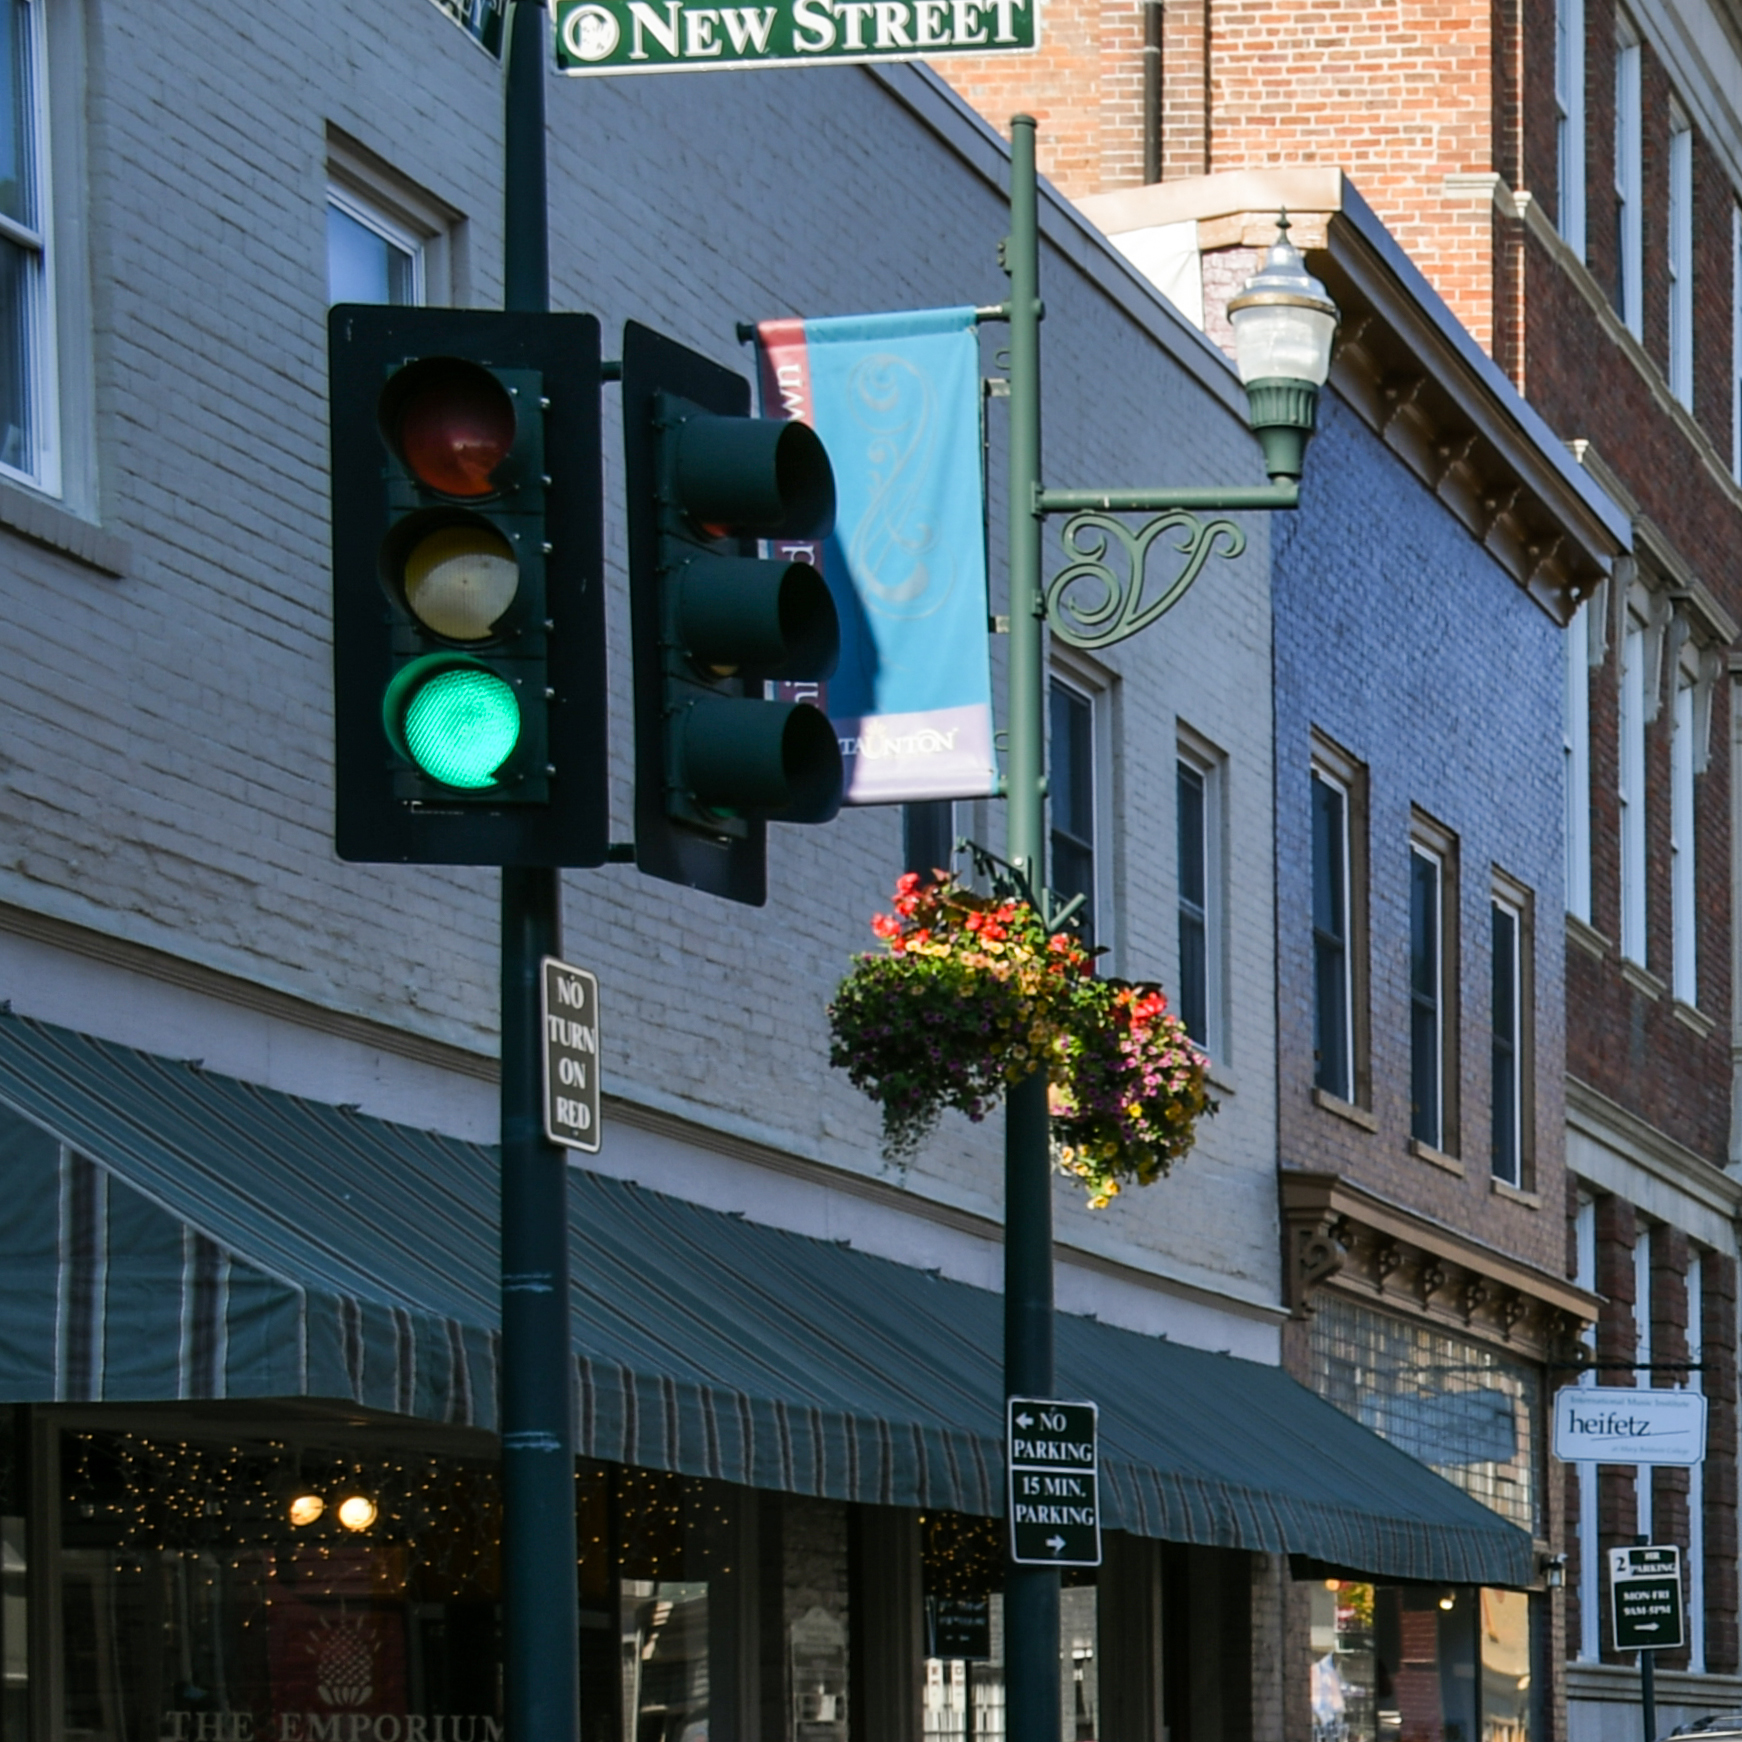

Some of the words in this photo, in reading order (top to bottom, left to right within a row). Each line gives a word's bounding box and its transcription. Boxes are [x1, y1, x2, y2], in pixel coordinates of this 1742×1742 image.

[629, 0, 776, 59] NEW
[793, 0, 1026, 54] STREET
[838, 726, 956, 761] TAUNTON
[556, 976, 585, 1010] NO
[548, 1014, 595, 1055] TURN
[558, 1057, 586, 1090] ON
[556, 1096, 591, 1130] RED
[1038, 1412, 1067, 1433] NO
[1568, 1409, 1652, 1436] heifetz
[1013, 1439, 1093, 1462] PARKING
[1022, 1476, 1041, 1495] 15
[1044, 1477, 1087, 1498] MIN.
[1015, 1504, 1095, 1526] PARKING
[1616, 1556, 1627, 1572] 2
[1631, 1563, 1677, 1573] PARKING
[165, 1709, 254, 1742] THE
